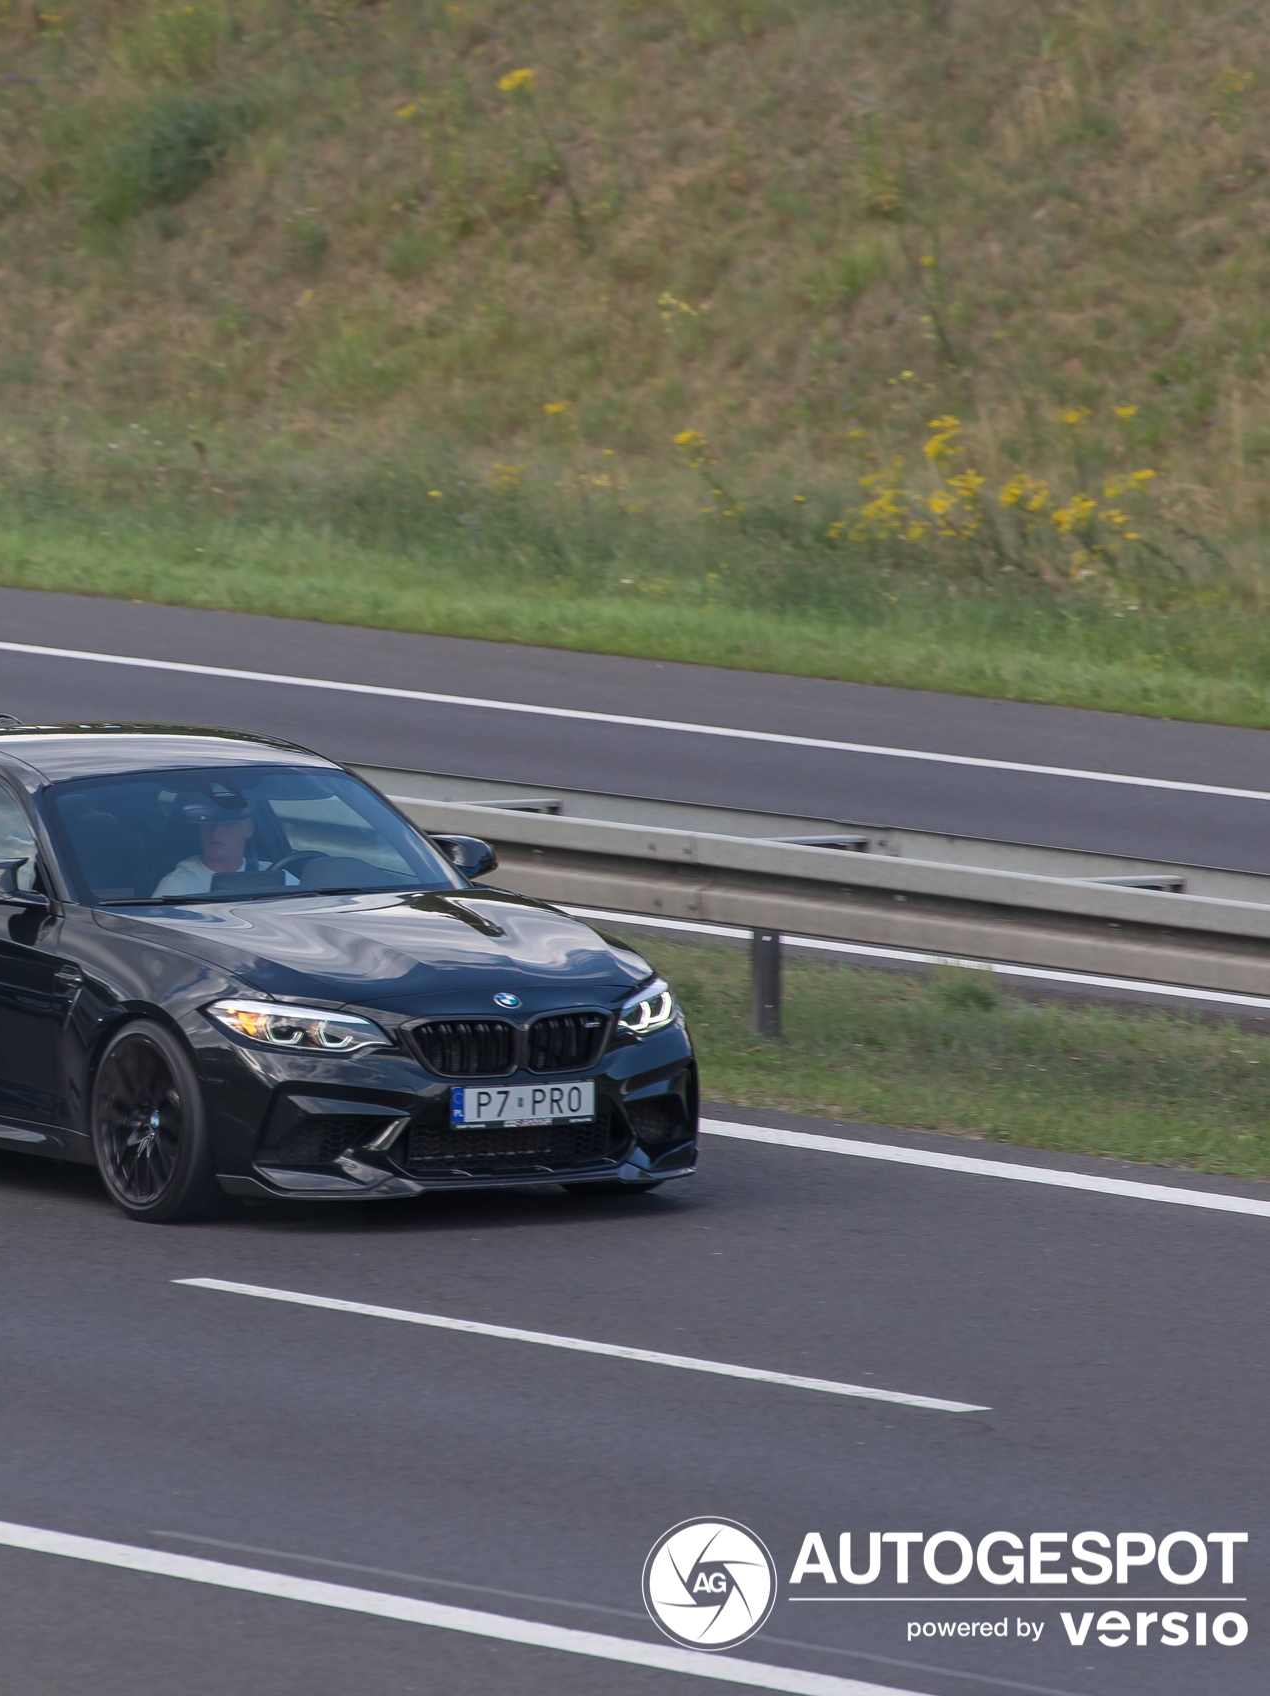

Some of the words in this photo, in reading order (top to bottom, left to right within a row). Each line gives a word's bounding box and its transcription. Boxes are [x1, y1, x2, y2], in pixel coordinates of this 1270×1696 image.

[476, 1090, 510, 1118] P7
[532, 1086, 581, 1115] PRO
[453, 1109, 464, 1117] PL
